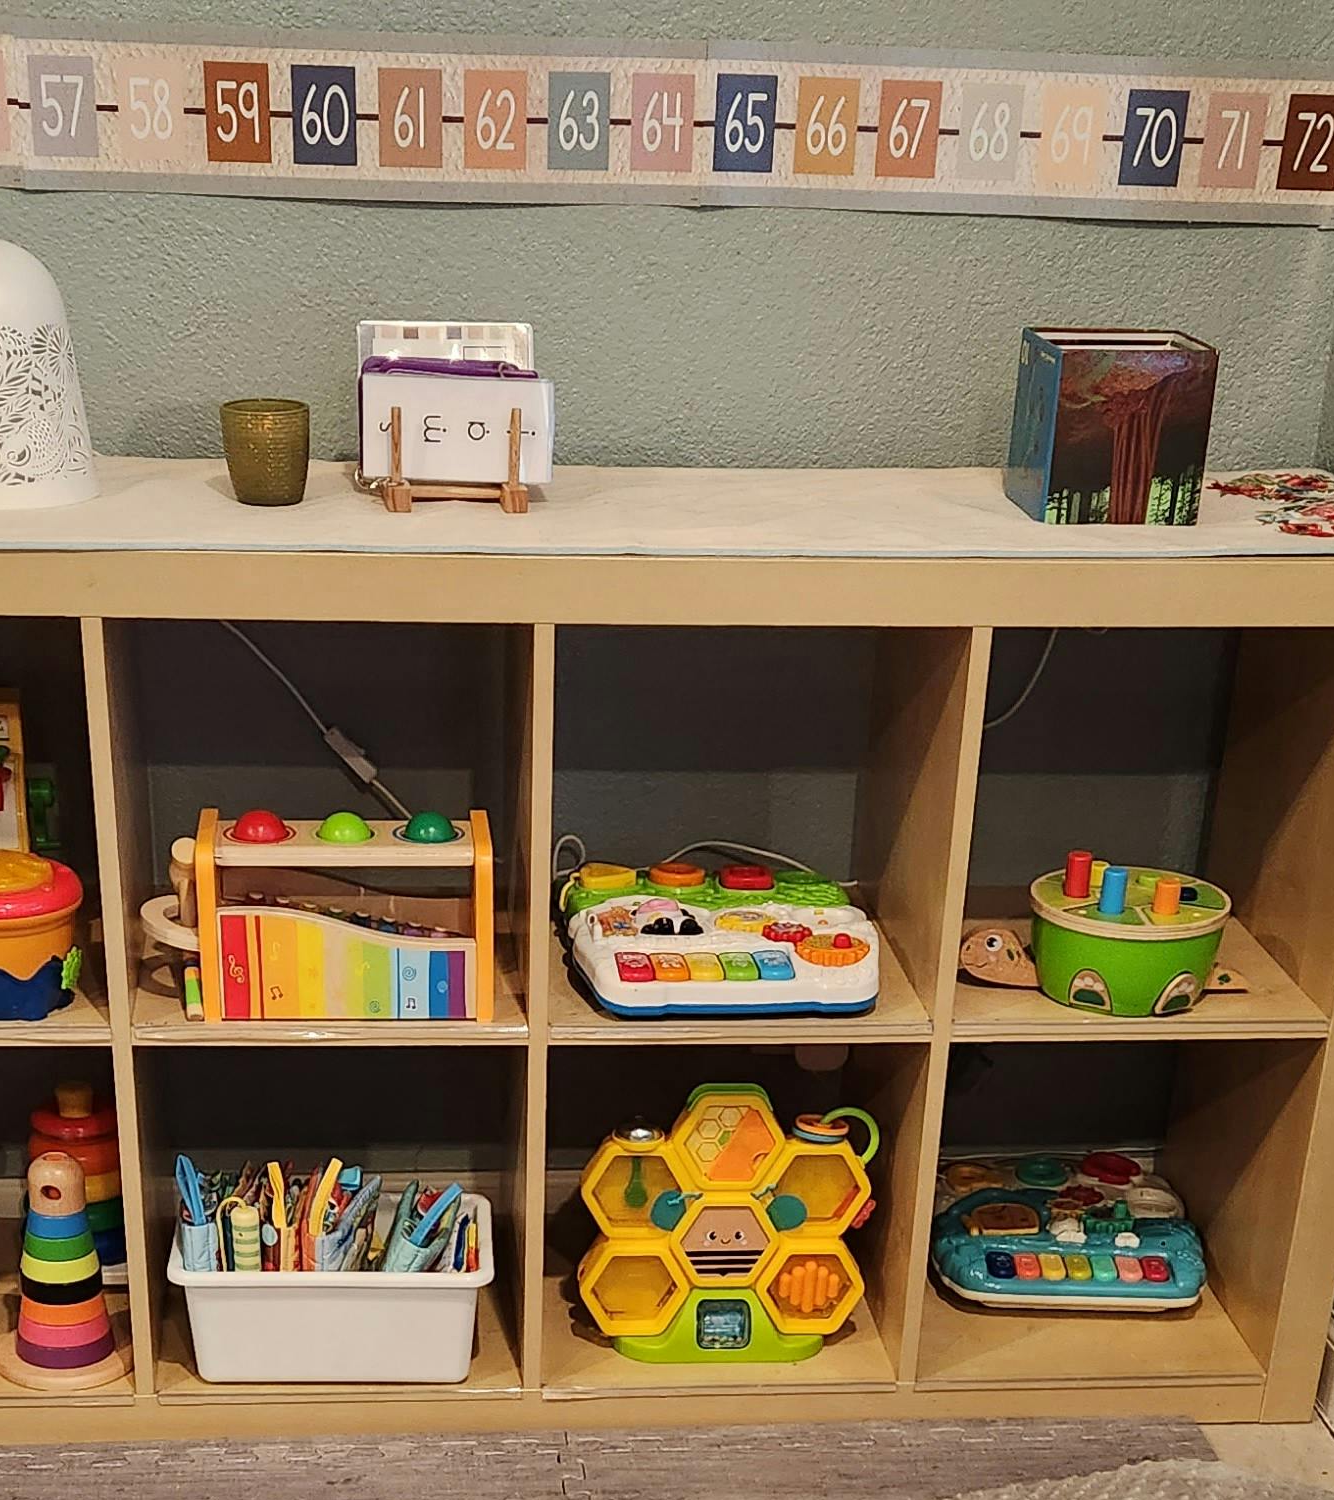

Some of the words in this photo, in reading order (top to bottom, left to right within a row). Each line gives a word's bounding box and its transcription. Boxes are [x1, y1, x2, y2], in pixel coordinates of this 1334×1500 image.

[40, 74, 84, 138] 57
[129, 77, 173, 140] 58
[215, 80, 261, 144] 59
[301, 83, 348, 147] 60
[394, 86, 426, 149] 61
[476, 88, 516, 151] 62
[558, 89, 600, 151] 63
[642, 91, 684, 154] 64
[724, 92, 768, 154] 65
[805, 95, 848, 157] 66
[888, 98, 930, 159] 67
[969, 102, 1010, 162] 68
[1050, 105, 1092, 165] 69
[1132, 107, 1178, 169] 70
[1217, 110, 1250, 170] 71
